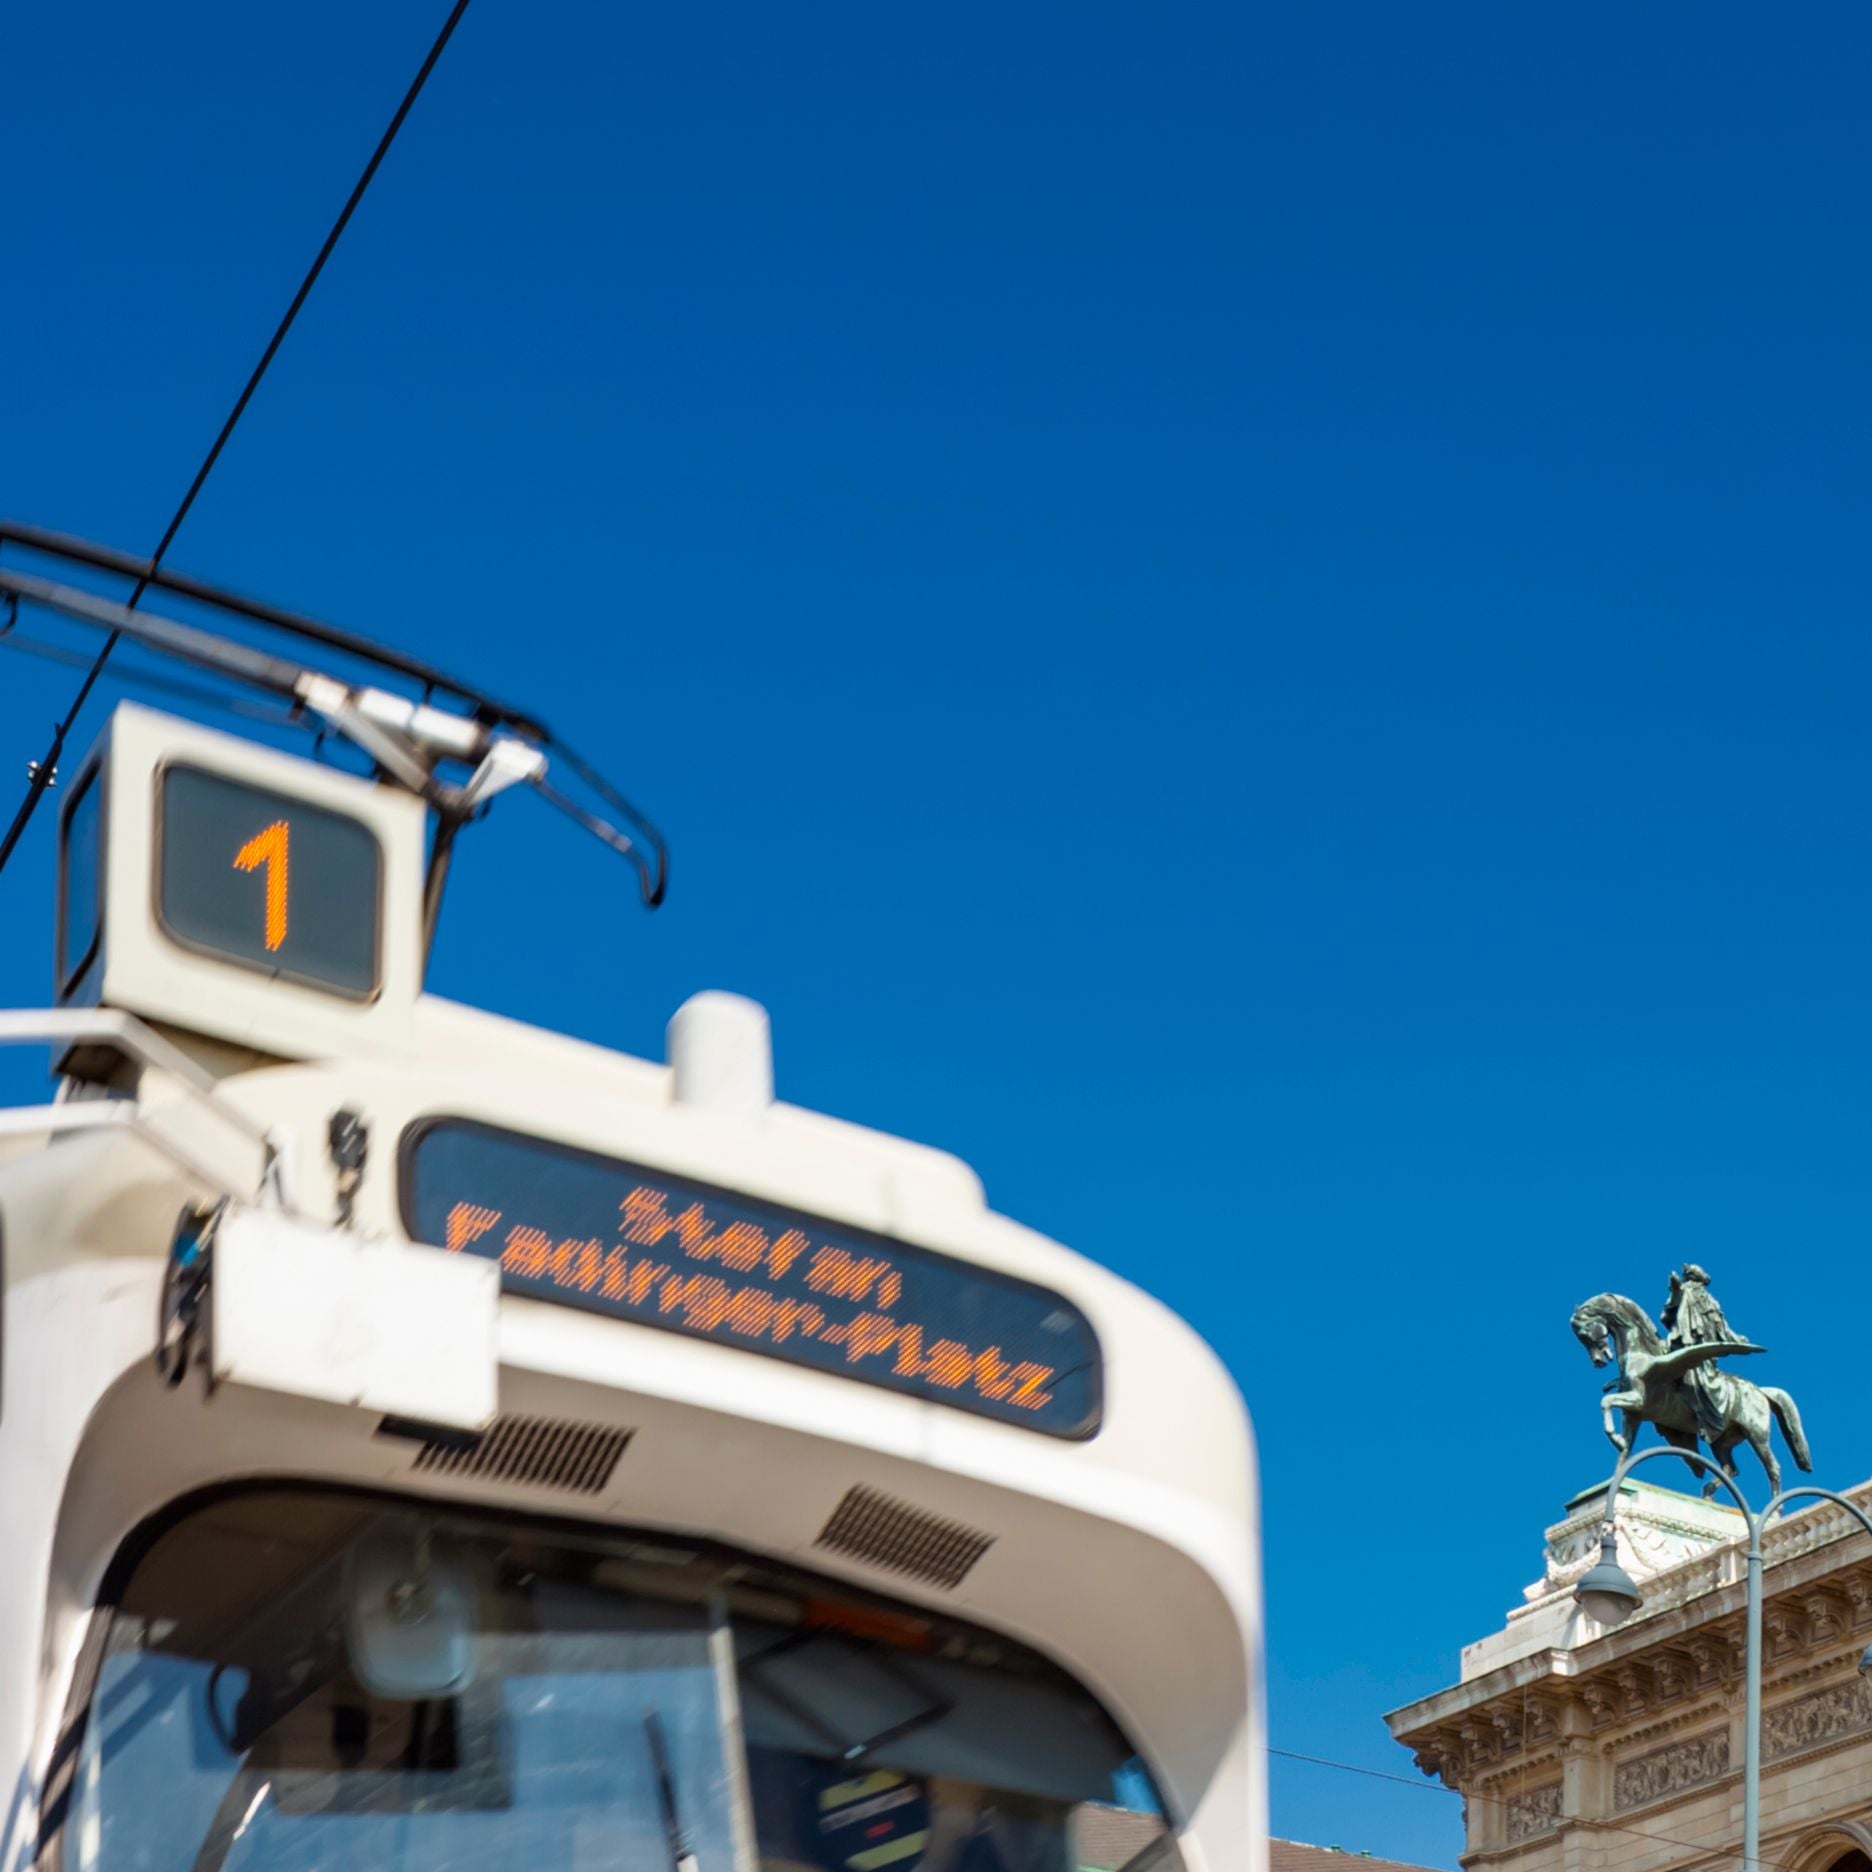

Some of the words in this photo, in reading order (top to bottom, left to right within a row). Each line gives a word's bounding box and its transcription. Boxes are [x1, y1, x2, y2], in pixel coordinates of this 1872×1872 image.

[232, 818, 289, 952] 1
[446, 1201, 1055, 1411] Fadinger-Platz
[619, 1186, 902, 1310] Stefan
